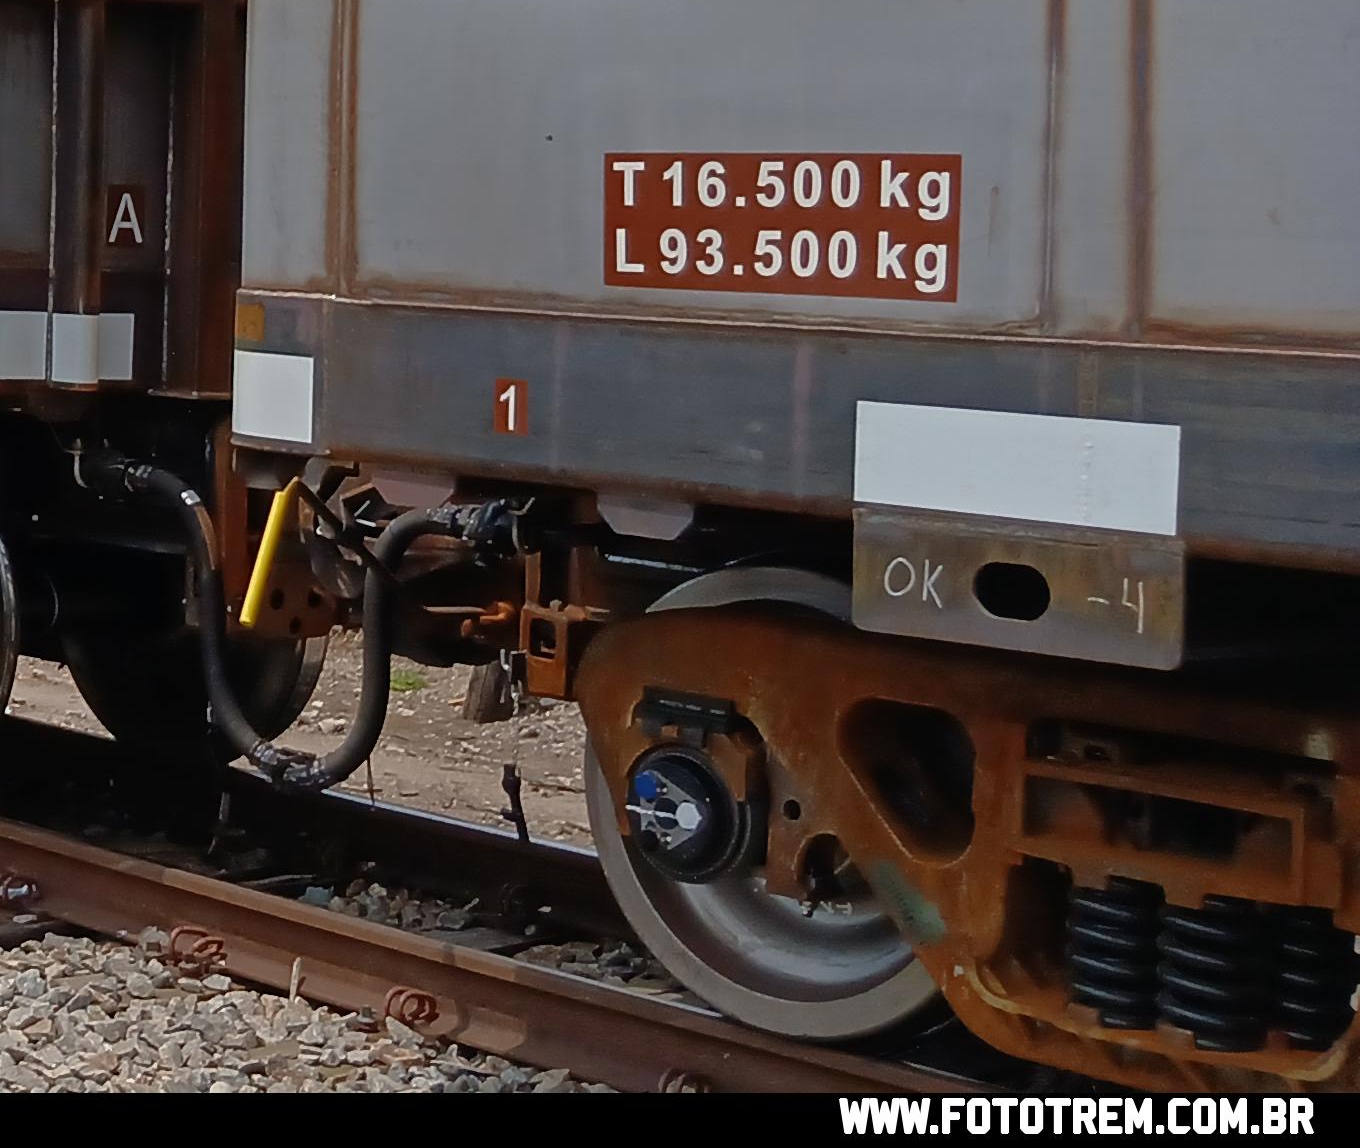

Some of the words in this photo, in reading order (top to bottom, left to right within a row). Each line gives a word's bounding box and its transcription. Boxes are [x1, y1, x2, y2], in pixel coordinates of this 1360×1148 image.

[613, 161, 645, 206] T
[662, 159, 860, 208] 16.500
[880, 159, 950, 221] kg
[108, 192, 143, 244] A
[616, 228, 645, 273] L
[659, 228, 858, 279] 93.500
[877, 230, 948, 293] kg
[499, 384, 516, 431] 1
[884, 557, 943, 609] OK
